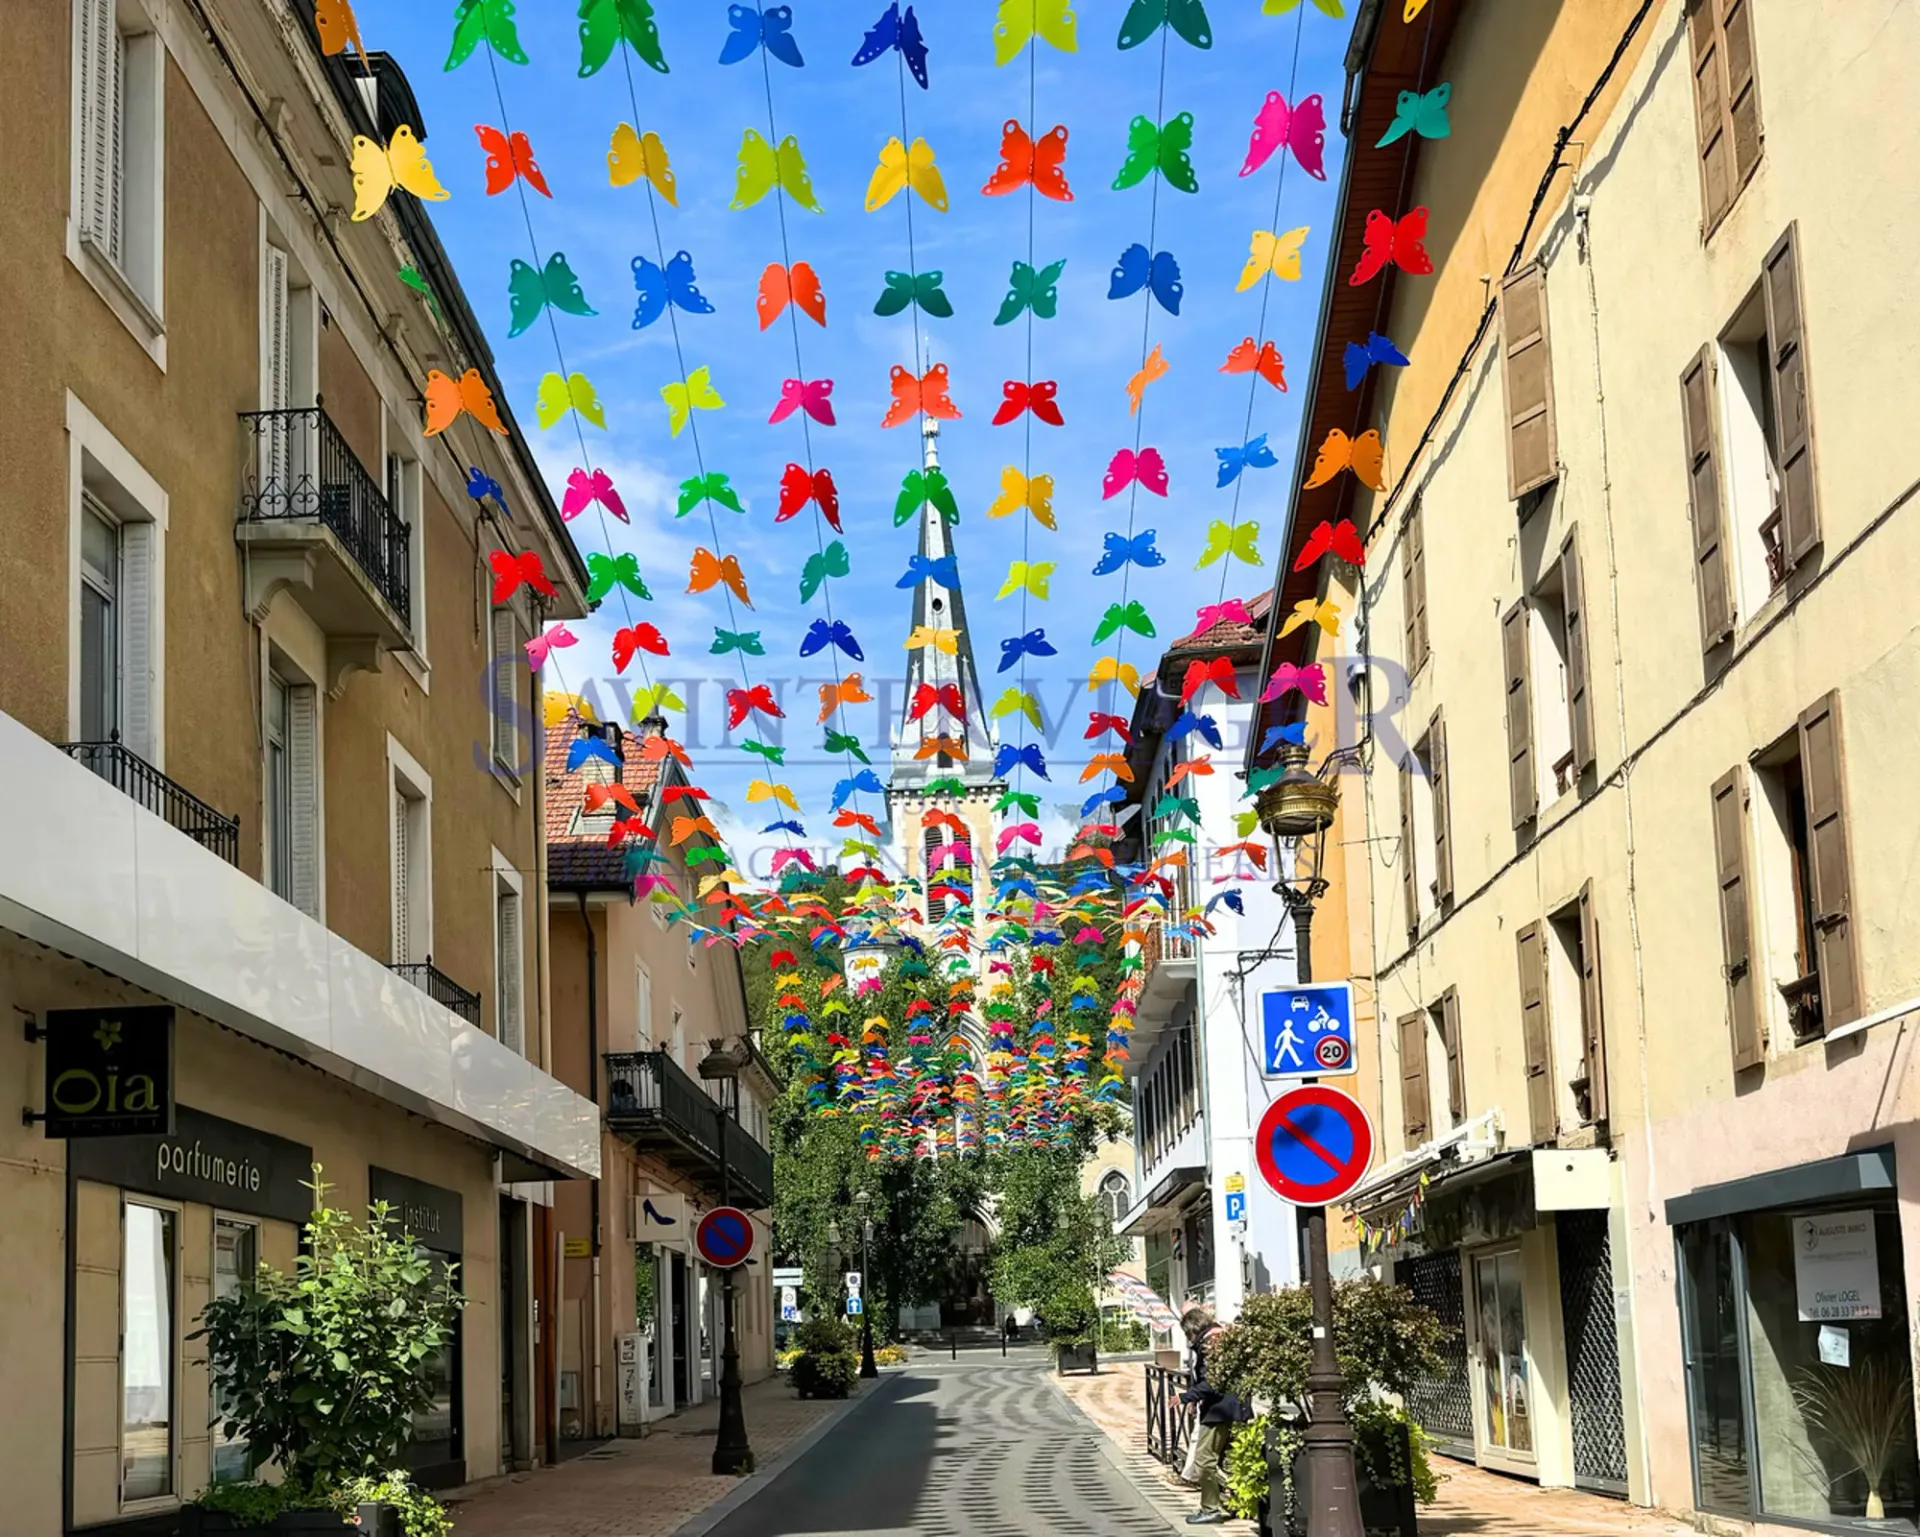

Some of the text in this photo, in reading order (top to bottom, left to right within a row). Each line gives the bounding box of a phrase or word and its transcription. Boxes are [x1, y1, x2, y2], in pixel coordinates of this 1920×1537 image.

[1322, 1045, 1342, 1058] 20
[52, 1065, 160, 1114] Oïa
[158, 1140, 260, 1192] parfumerie
[1231, 1198, 1240, 1217] P
[403, 1202, 441, 1233] institut
[1838, 1290, 1861, 1302] LOGEL
[1820, 1306, 1831, 1318] 06
